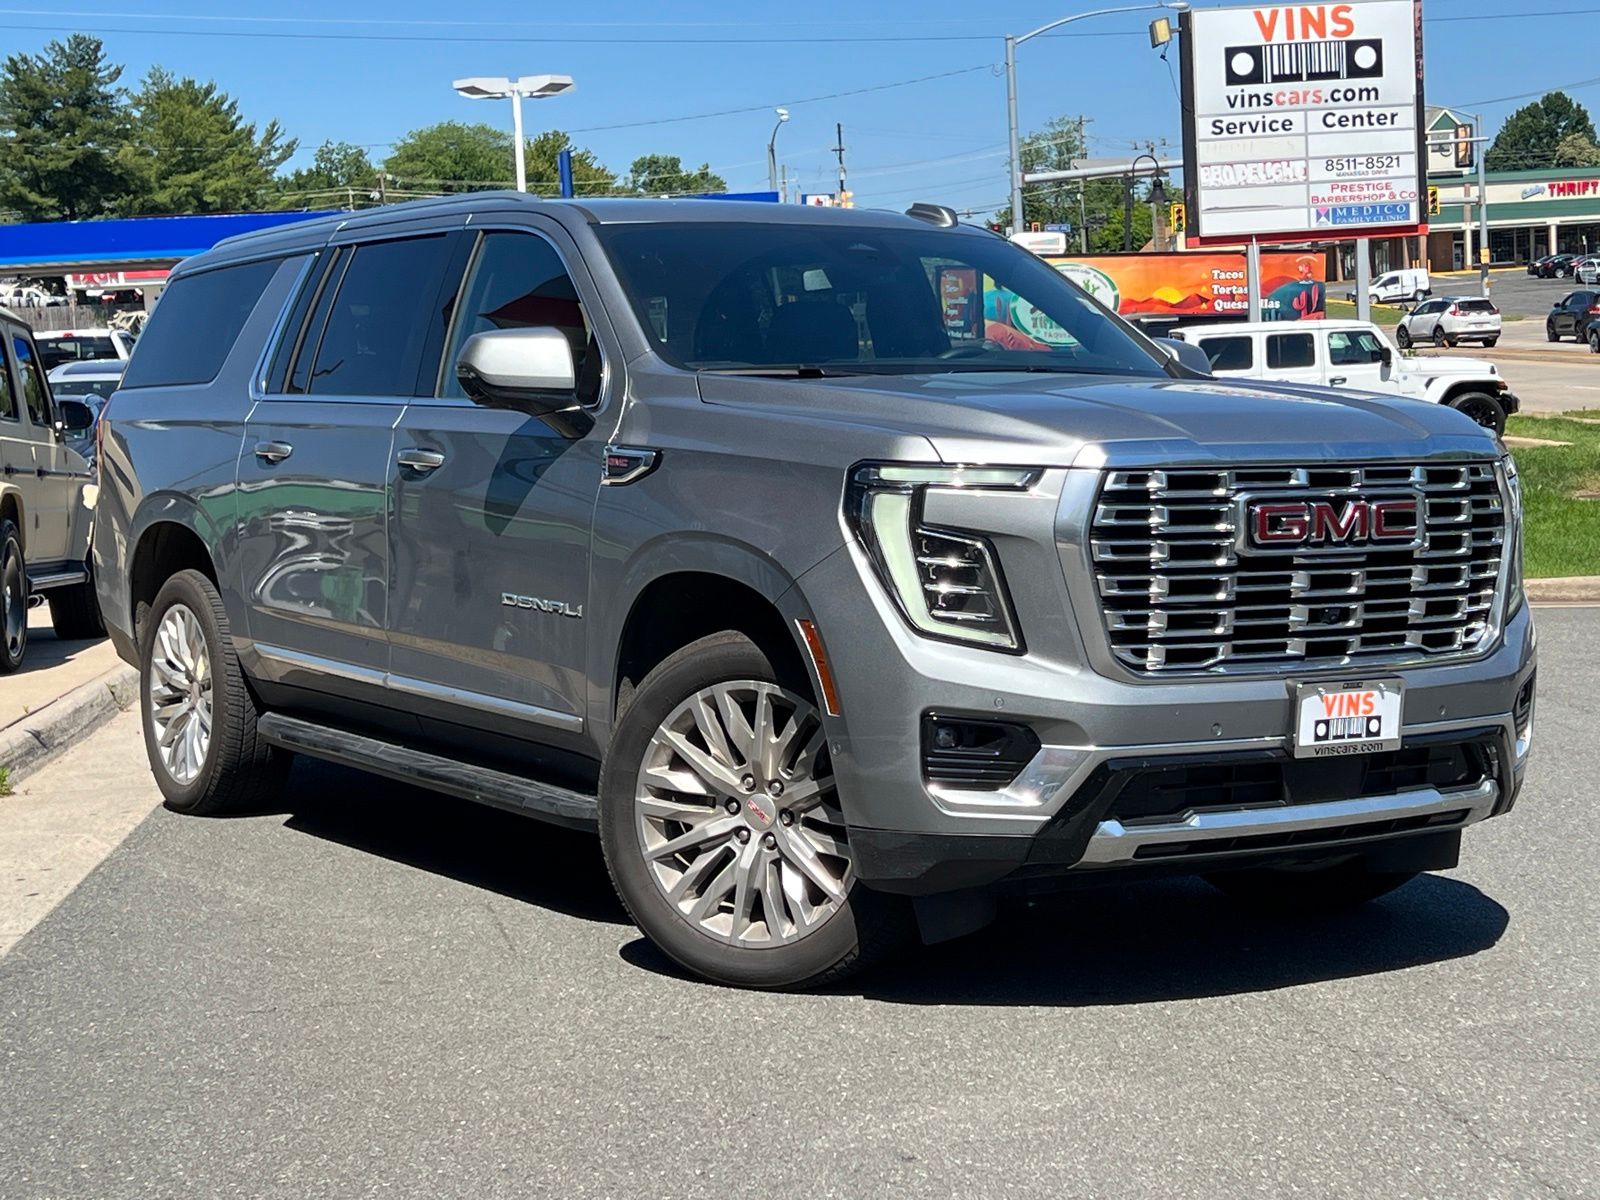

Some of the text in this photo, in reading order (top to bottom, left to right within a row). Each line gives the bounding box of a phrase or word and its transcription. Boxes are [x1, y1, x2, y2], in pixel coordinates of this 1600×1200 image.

[1253, 4, 1355, 42] VINS
[1226, 86, 1379, 109] vinscars.com
[1211, 110, 1399, 136] Service Center
[1325, 156, 1400, 172] 8511-8521
[1330, 182, 1393, 193] PRESTIGE
[1548, 181, 1599, 197] THRIFT
[1311, 193, 1386, 204] BARBERSHOP
[1388, 191, 1397, 200] &
[1336, 204, 1406, 217] MEDICO
[1336, 216, 1372, 224] FAMILY
[1211, 269, 1244, 280] Tacos
[1253, 500, 1417, 545] GMC
[501, 592, 583, 618] DENALI
[1323, 691, 1375, 717] VINS
[1314, 743, 1383, 755] vinscars.com
